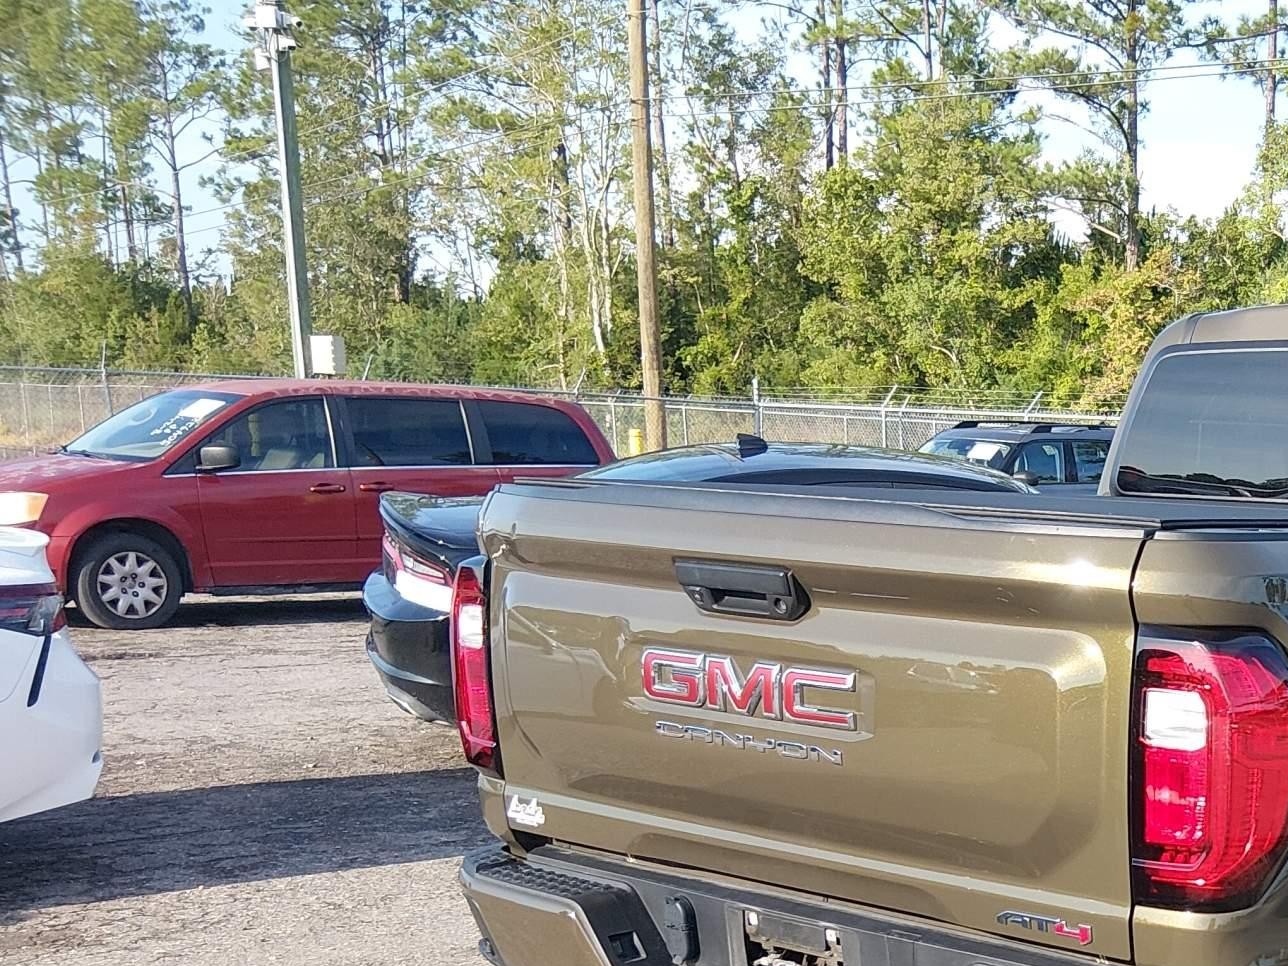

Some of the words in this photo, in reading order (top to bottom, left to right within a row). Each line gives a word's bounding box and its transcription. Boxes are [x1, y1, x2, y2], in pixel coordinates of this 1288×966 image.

[641, 647, 857, 731] GMC
[655, 720, 843, 766] CANYON
[995, 909, 1093, 946] AT4
